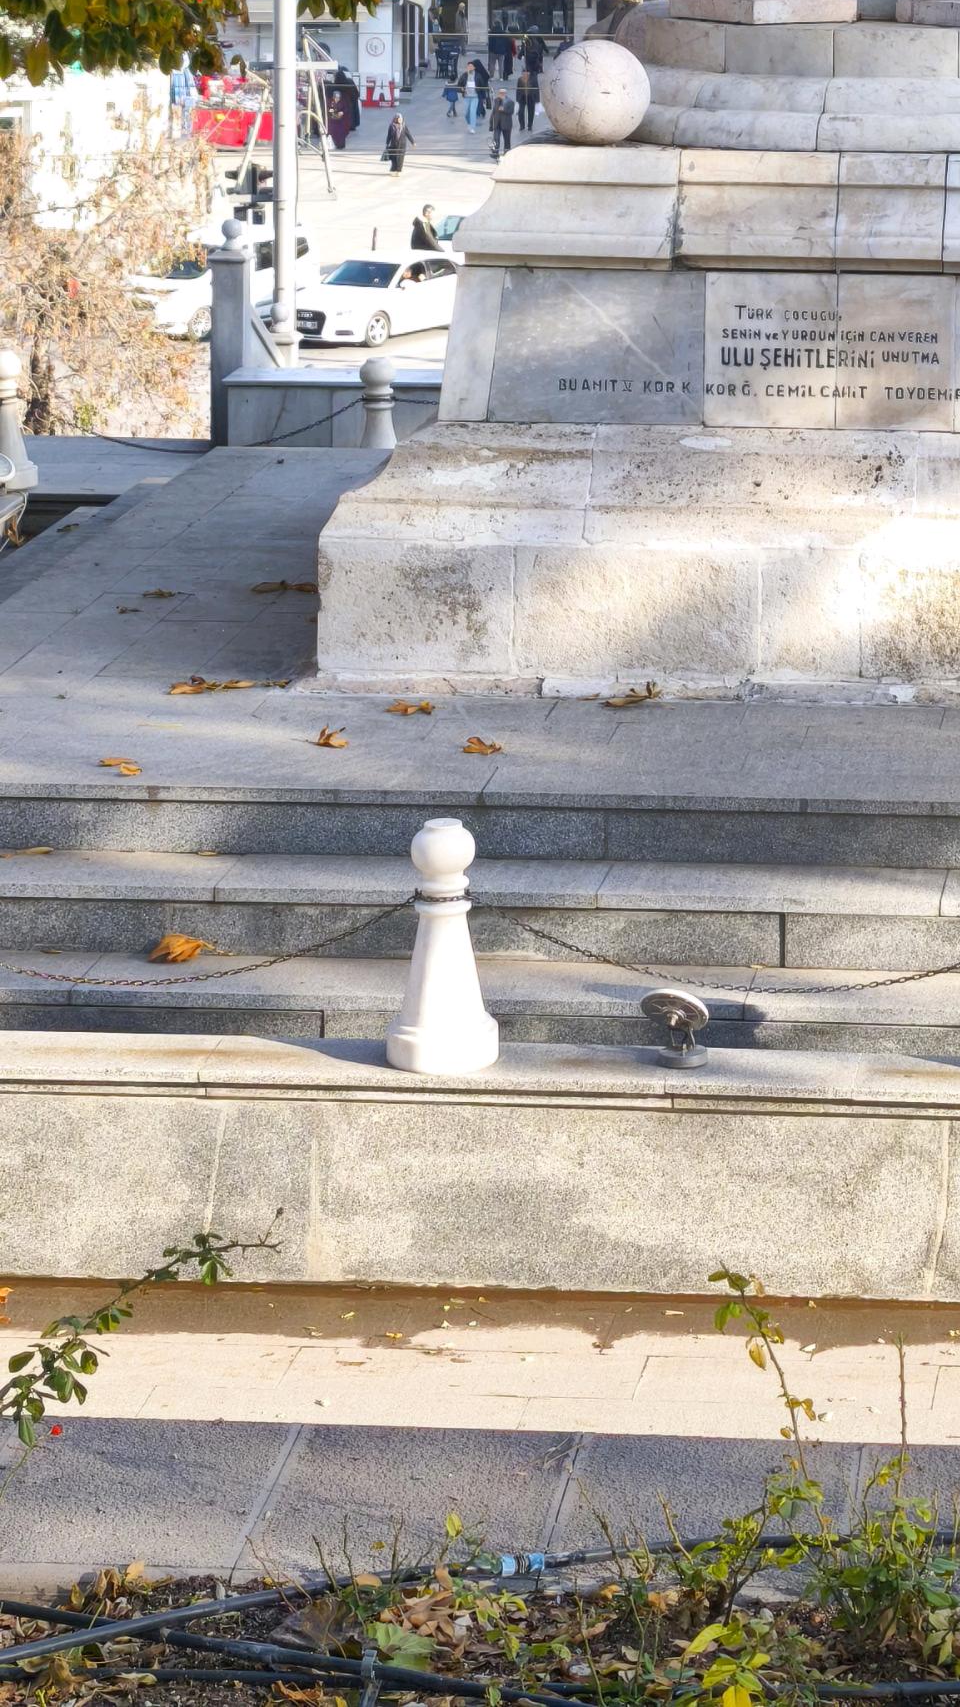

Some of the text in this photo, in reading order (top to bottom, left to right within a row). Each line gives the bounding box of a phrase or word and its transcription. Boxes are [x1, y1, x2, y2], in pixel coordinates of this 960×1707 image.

[781, 329, 836, 342] YURDUN
[870, 330, 895, 343] CAN
[898, 331, 938, 344] VEREN
[721, 346, 754, 368] ULU
[882, 350, 940, 364] UNUTMA
